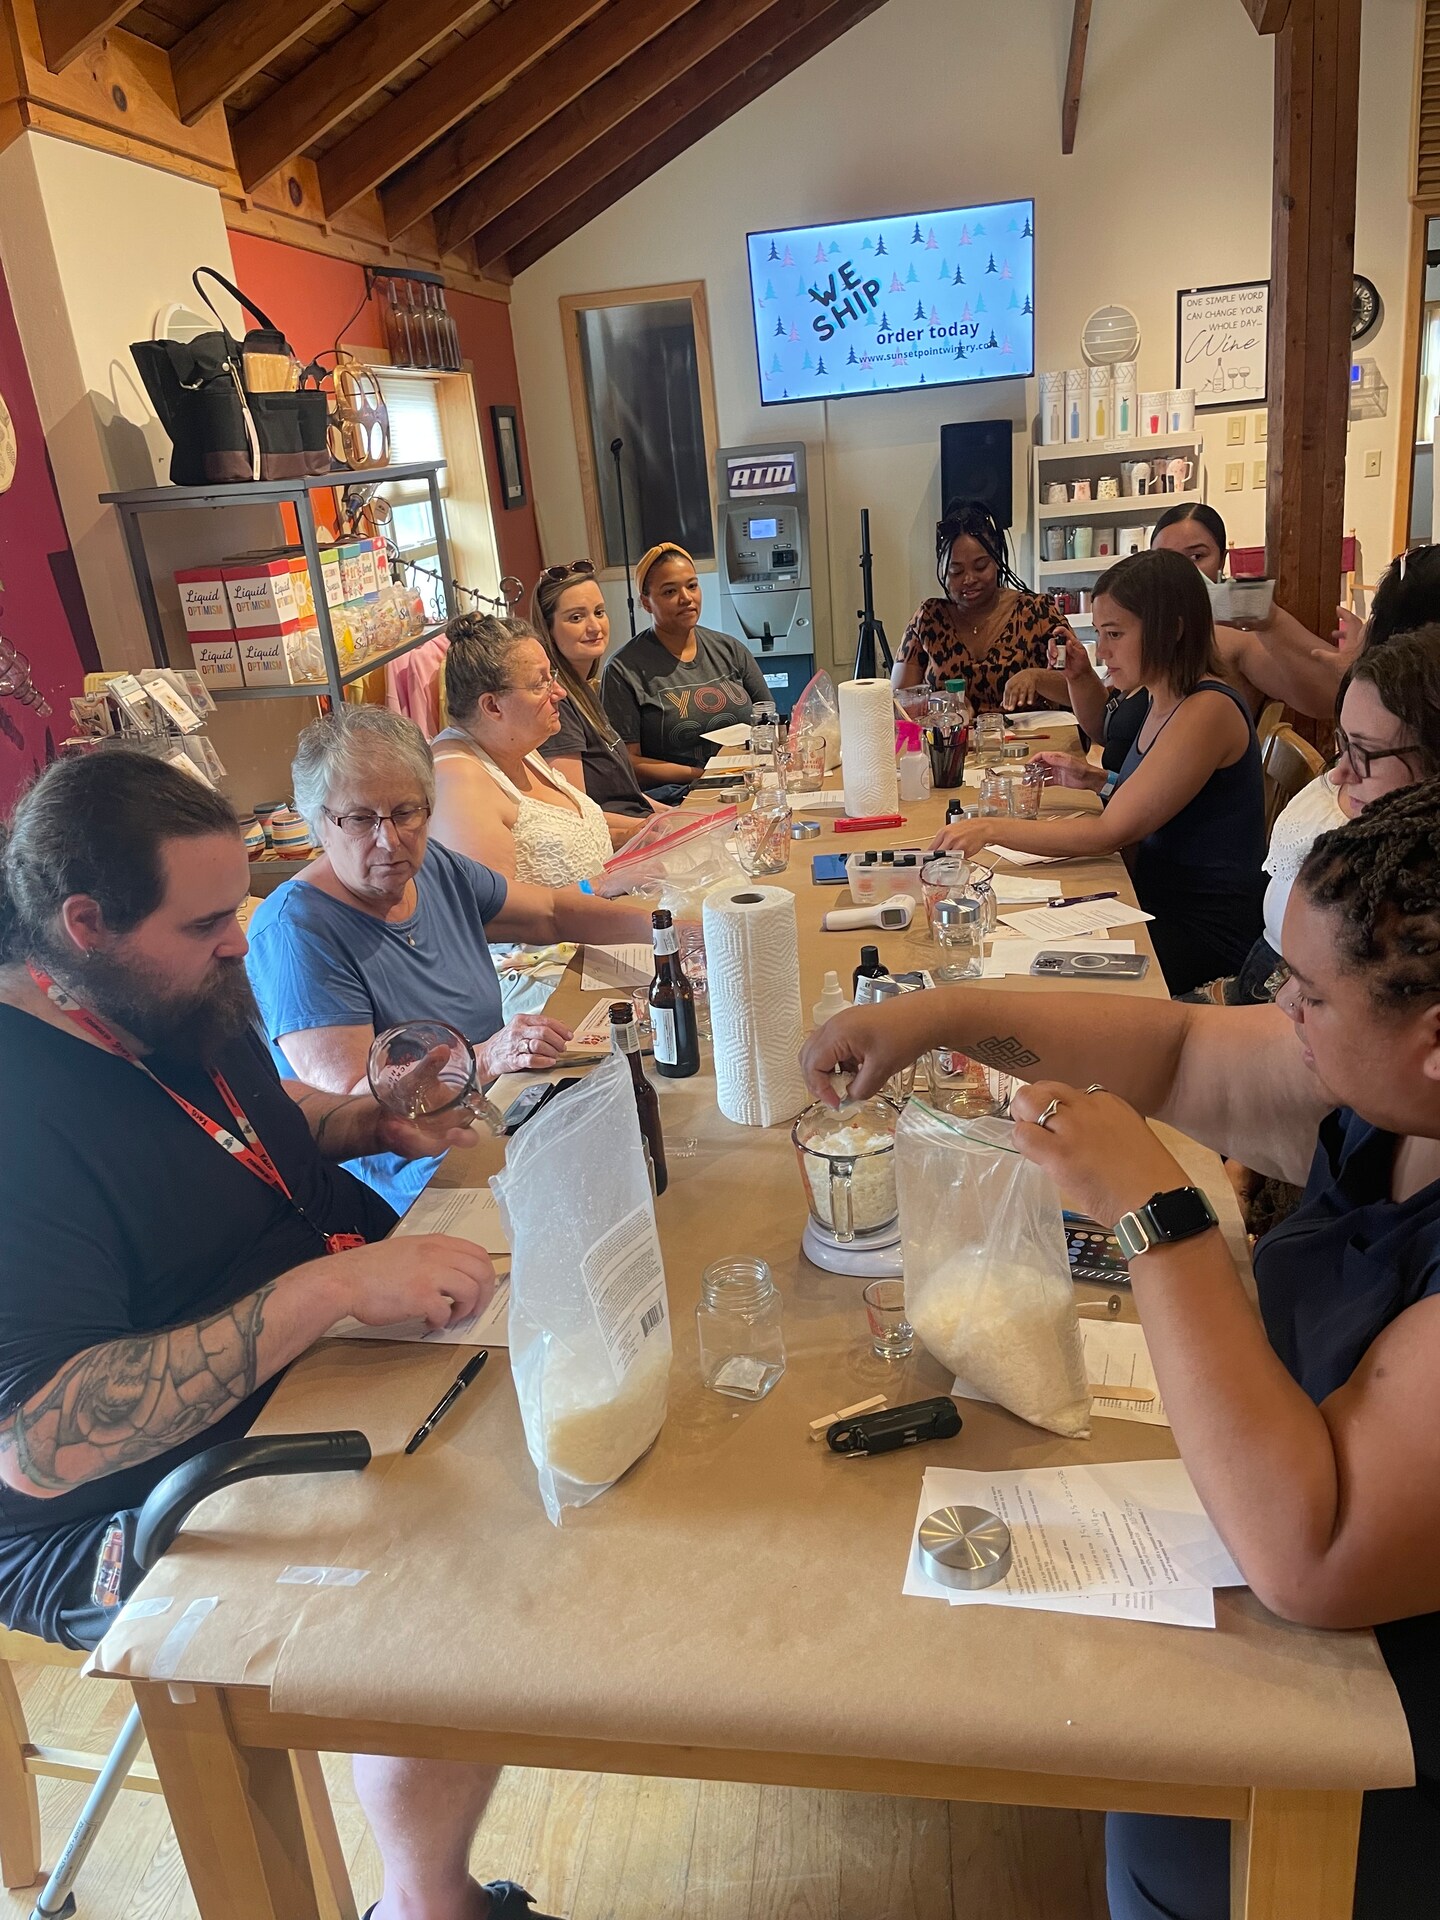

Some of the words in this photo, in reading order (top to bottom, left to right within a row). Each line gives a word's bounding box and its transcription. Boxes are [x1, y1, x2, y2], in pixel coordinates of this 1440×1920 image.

[808, 261, 861, 307] WE
[1186, 298, 1203, 307] ONE
[1206, 294, 1236, 304] SIMPLE
[1238, 292, 1264, 301] WORD
[812, 279, 880, 342] SHIP
[1186, 313, 1203, 321] CAN
[1205, 308, 1237, 319] CHANGE
[1240, 305, 1264, 315] YOUR
[876, 327, 924, 345] order
[930, 321, 980, 341] today
[1209, 321, 1238, 331] WHOLE
[1185, 329, 1261, 363] Wine
[731, 465, 793, 488] ATM
[185, 589, 219, 604] Liquid
[234, 583, 267, 600] Liquid
[187, 605, 223, 616] OPTIMISM
[236, 600, 272, 613] OPTIMISM
[200, 648, 233, 664] Liquid
[246, 645, 280, 660] Liquid
[201, 663, 237, 675] OPTIMISM
[247, 660, 283, 672] OPTIMISM
[664, 680, 748, 719] YOU
